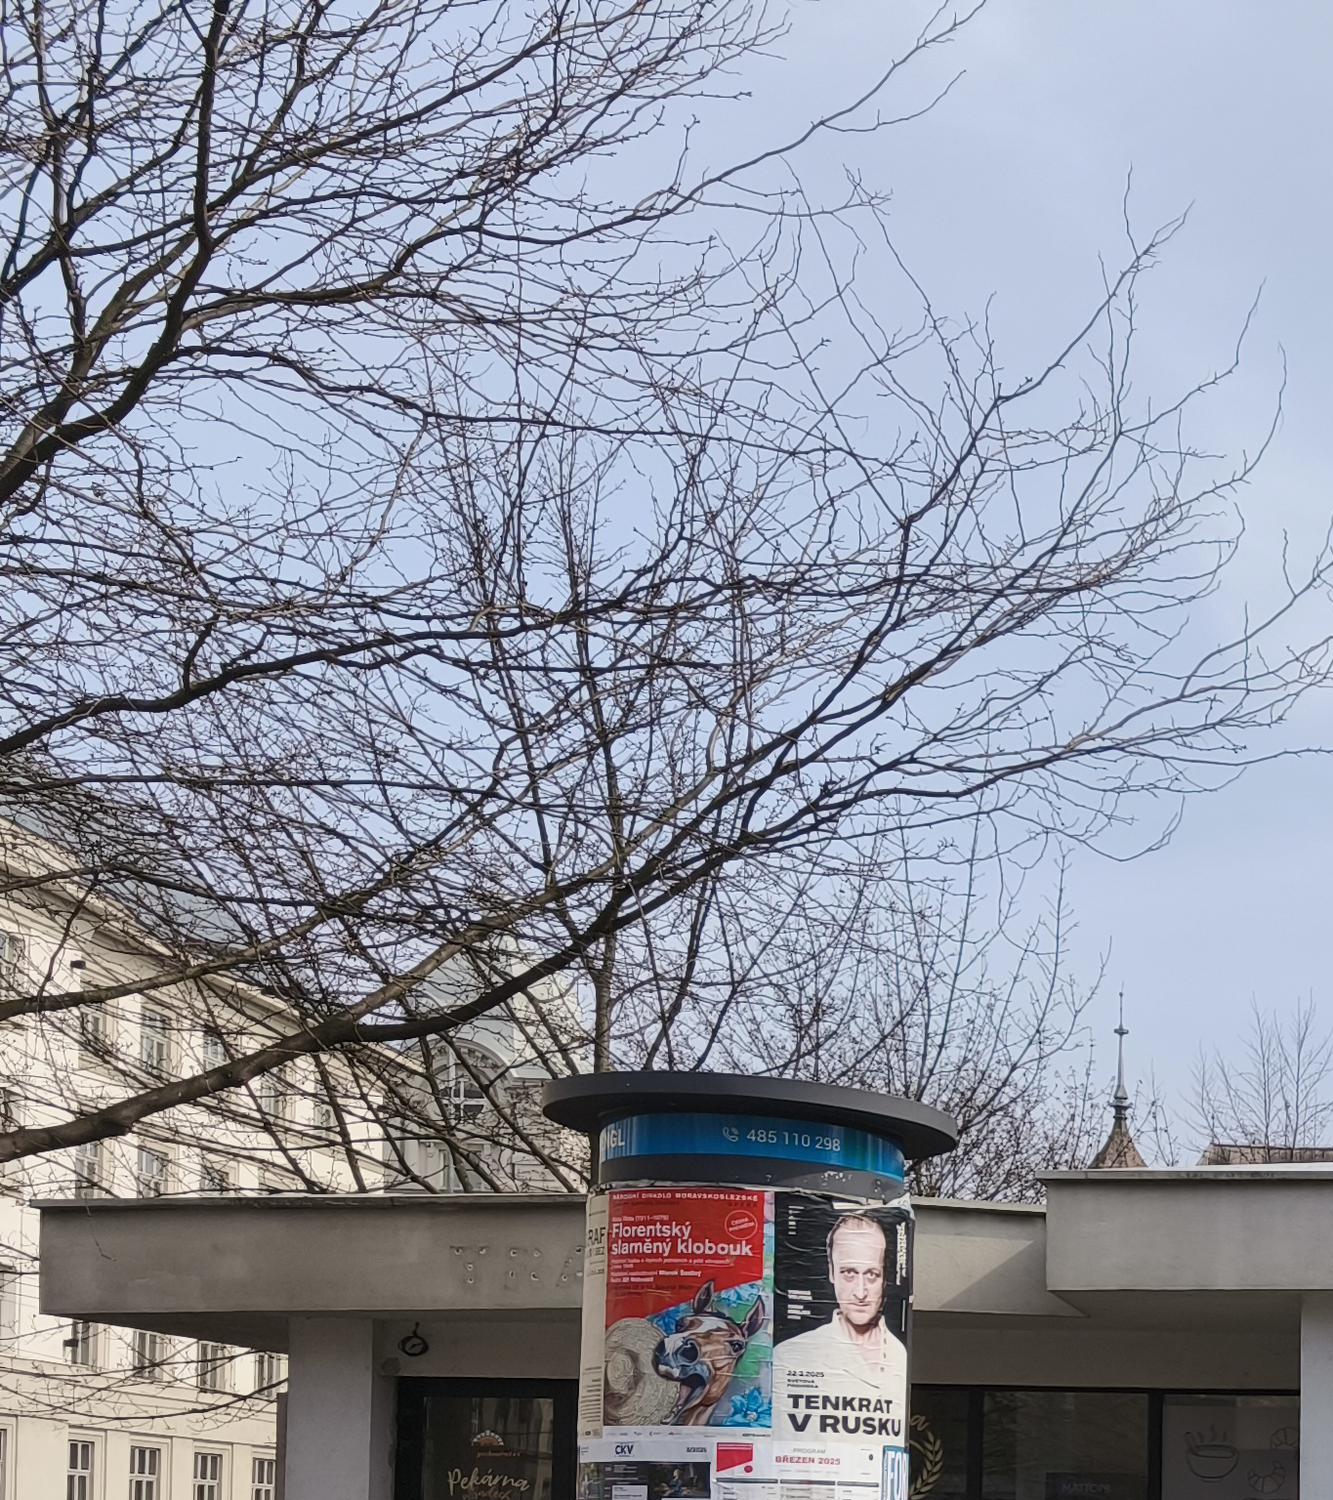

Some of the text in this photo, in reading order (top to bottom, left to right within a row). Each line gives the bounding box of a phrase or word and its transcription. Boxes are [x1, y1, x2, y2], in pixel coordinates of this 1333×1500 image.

[747, 1129, 842, 1151] 485 110 298
[612, 1221, 691, 1240] Florentský
[611, 1239, 753, 1257] slaměný klobouk
[787, 1413, 812, 1433] V
[819, 1415, 901, 1437] RUSKU
[615, 1445, 634, 1455] CKV
[775, 1455, 815, 1464] BŘEZEN
[448, 1467, 531, 1496] Pekárna
